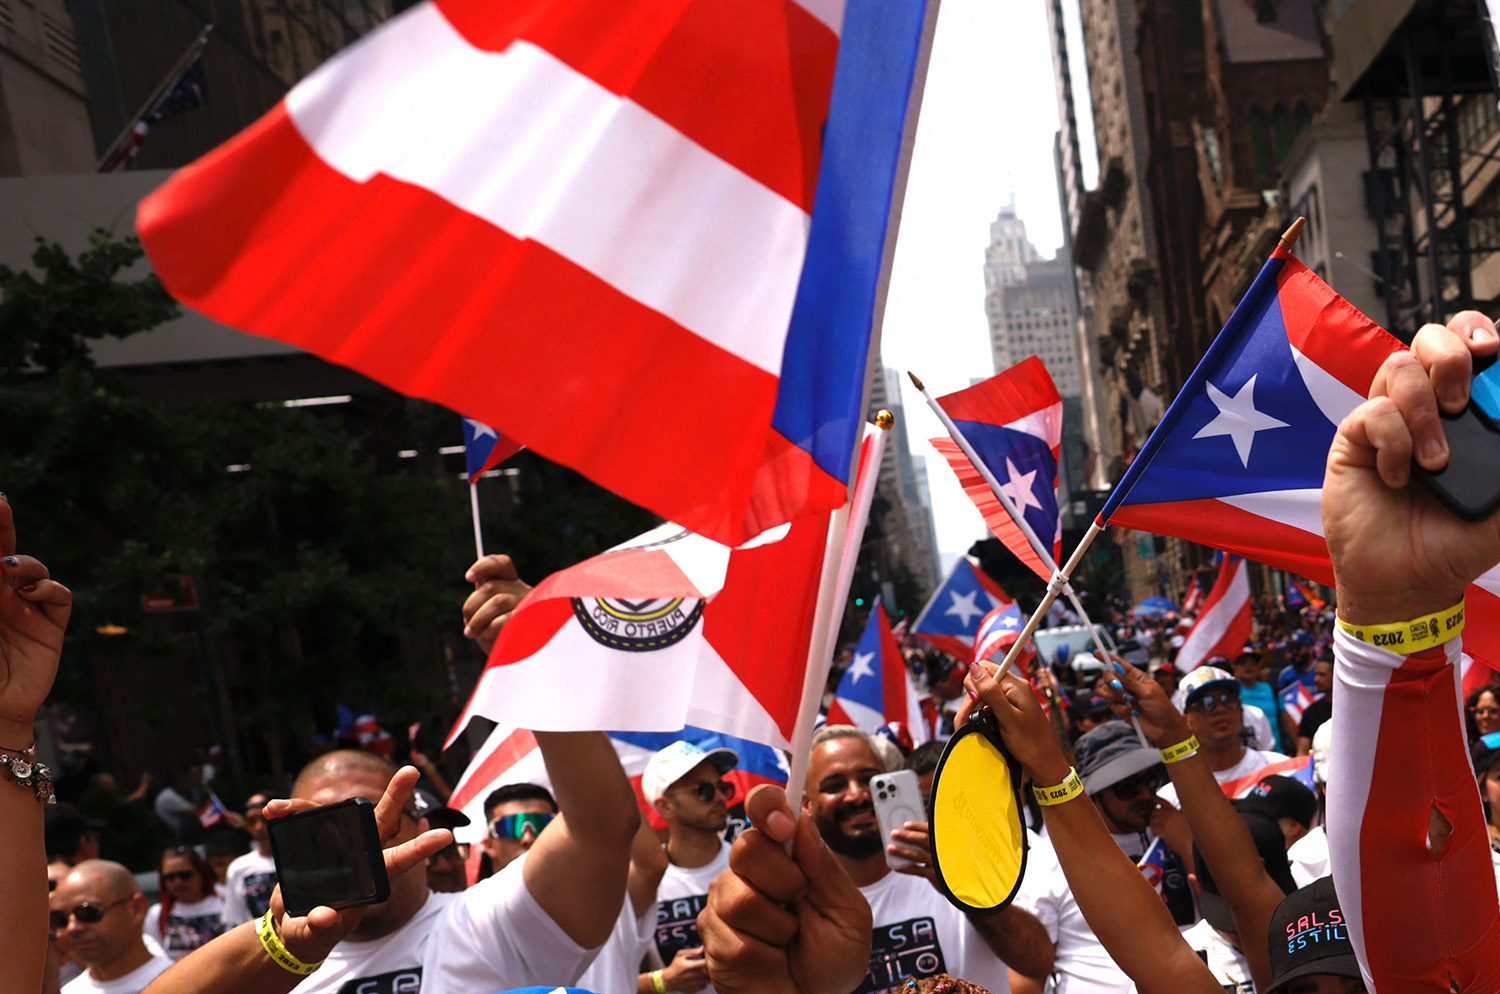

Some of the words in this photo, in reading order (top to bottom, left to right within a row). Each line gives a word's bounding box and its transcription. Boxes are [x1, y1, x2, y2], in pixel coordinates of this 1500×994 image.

[1373, 631, 1405, 646] 2023
[1050, 787, 1068, 799] 2023
[278, 954, 300, 970] 2023
